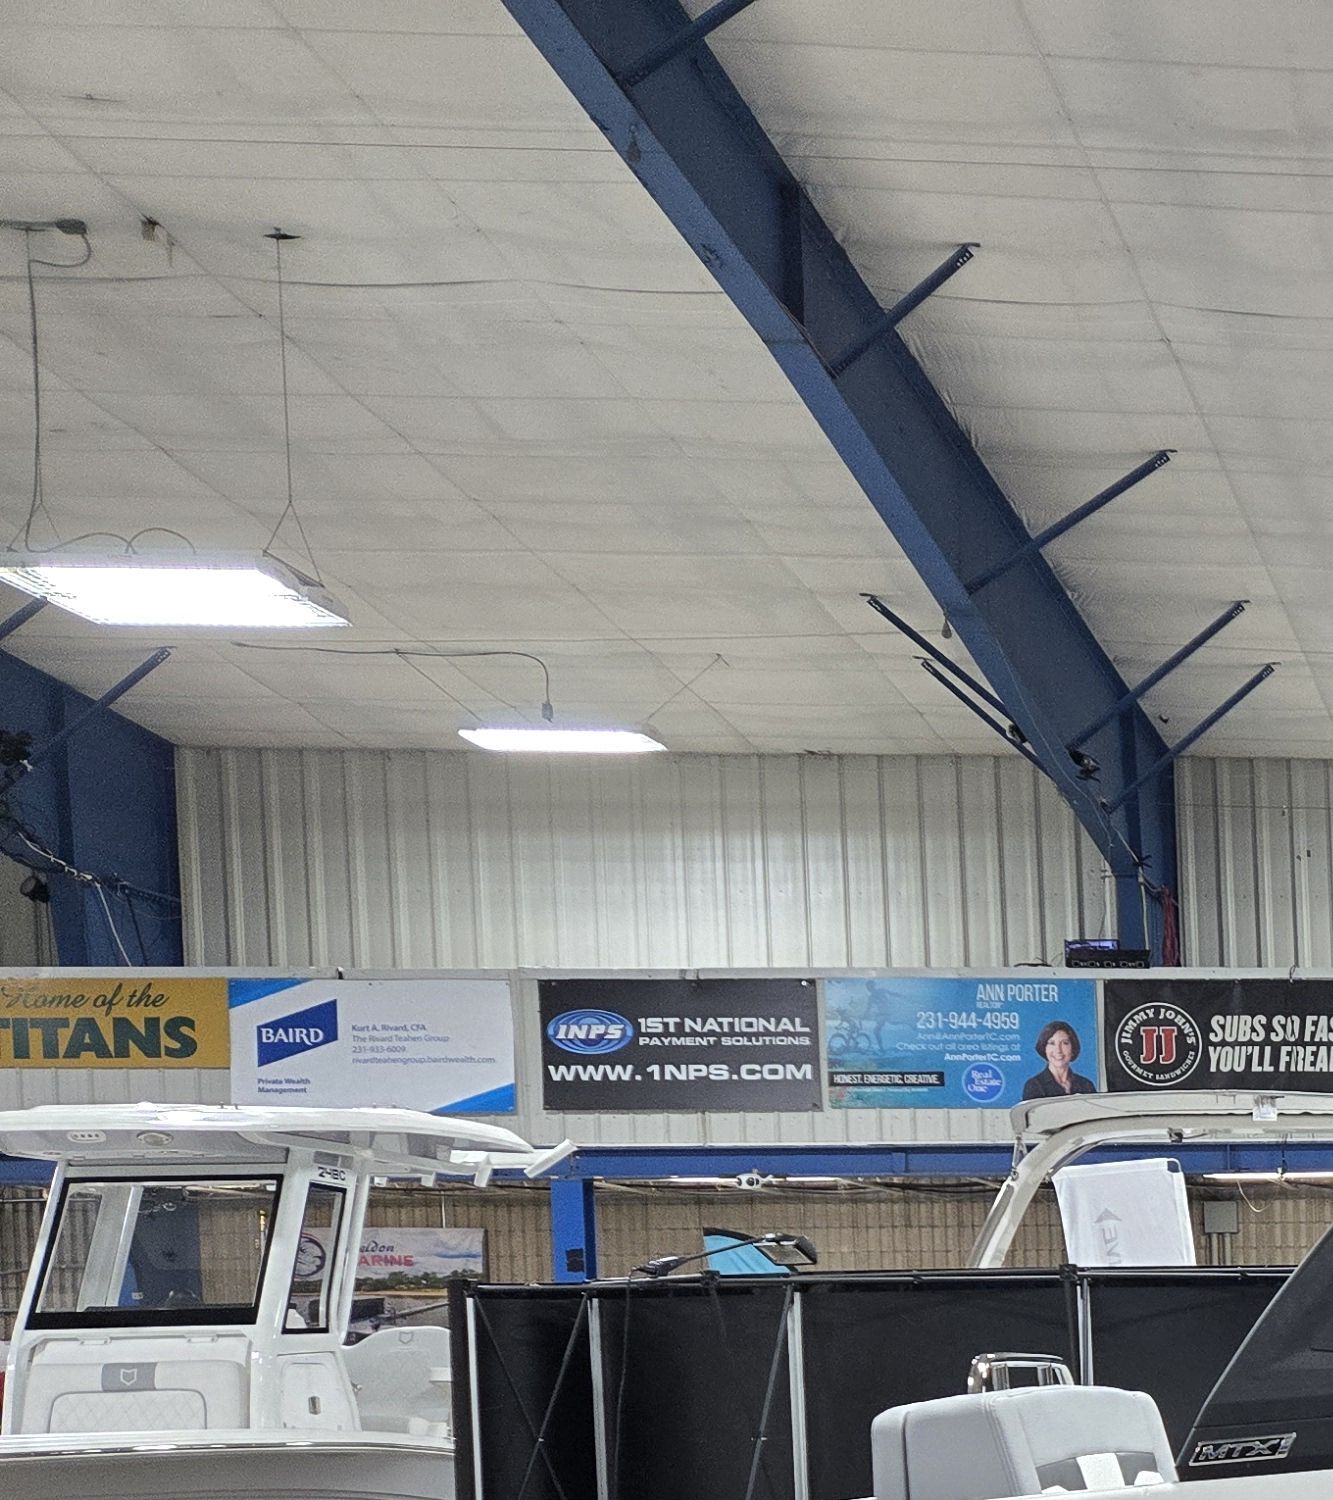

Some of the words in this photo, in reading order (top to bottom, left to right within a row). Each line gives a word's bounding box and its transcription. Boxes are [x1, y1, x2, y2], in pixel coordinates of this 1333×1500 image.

[2, 985, 88, 1009] Home
[93, 982, 124, 1017] of
[126, 982, 170, 1008] the
[976, 984, 1005, 1001] ANN
[1007, 984, 1059, 1002] PORTER
[352, 1024, 369, 1032] Kurt
[371, 1024, 379, 1032] A.
[381, 1024, 407, 1033] Rivard,
[410, 1024, 426, 1032] CFA
[638, 1018, 680, 1033] 1ST
[684, 1017, 811, 1033] NATIONAL
[916, 1011, 1020, 1030] 231-944-4959
[1121, 1008, 1155, 1044] JIMMY
[1159, 1008, 1197, 1046] JOHN'S
[1209, 1015, 1266, 1043] SUBS
[1270, 1015, 1299, 1043] SO
[0, 1016, 198, 1059] ITANS
[260, 1027, 324, 1046] BAIRD
[352, 1035, 366, 1043] The
[368, 1035, 392, 1043] Rivard
[425, 1035, 450, 1044] Group
[639, 1037, 717, 1046] PAYMENT
[721, 1036, 811, 1046] SOLUTIONS
[1140, 1026, 1178, 1064] JJ
[896, 1042, 926, 1051] Check
[928, 1042, 944, 1051] out
[1010, 1042, 1021, 1051] at
[944, 1053, 1021, 1062] AnnPorterTC.com
[1122, 1050, 1154, 1079] GOURMET
[1155, 1051, 1195, 1080] SANDWICHES
[1208, 1046, 1274, 1073] YOU'LL
[971, 1070, 993, 1079] Real
[257, 1086, 307, 1094] Management
[359, 1240, 395, 1253] eldon
[358, 1255, 414, 1267] ARINE
[1199, 1439, 1281, 1460] MTX
